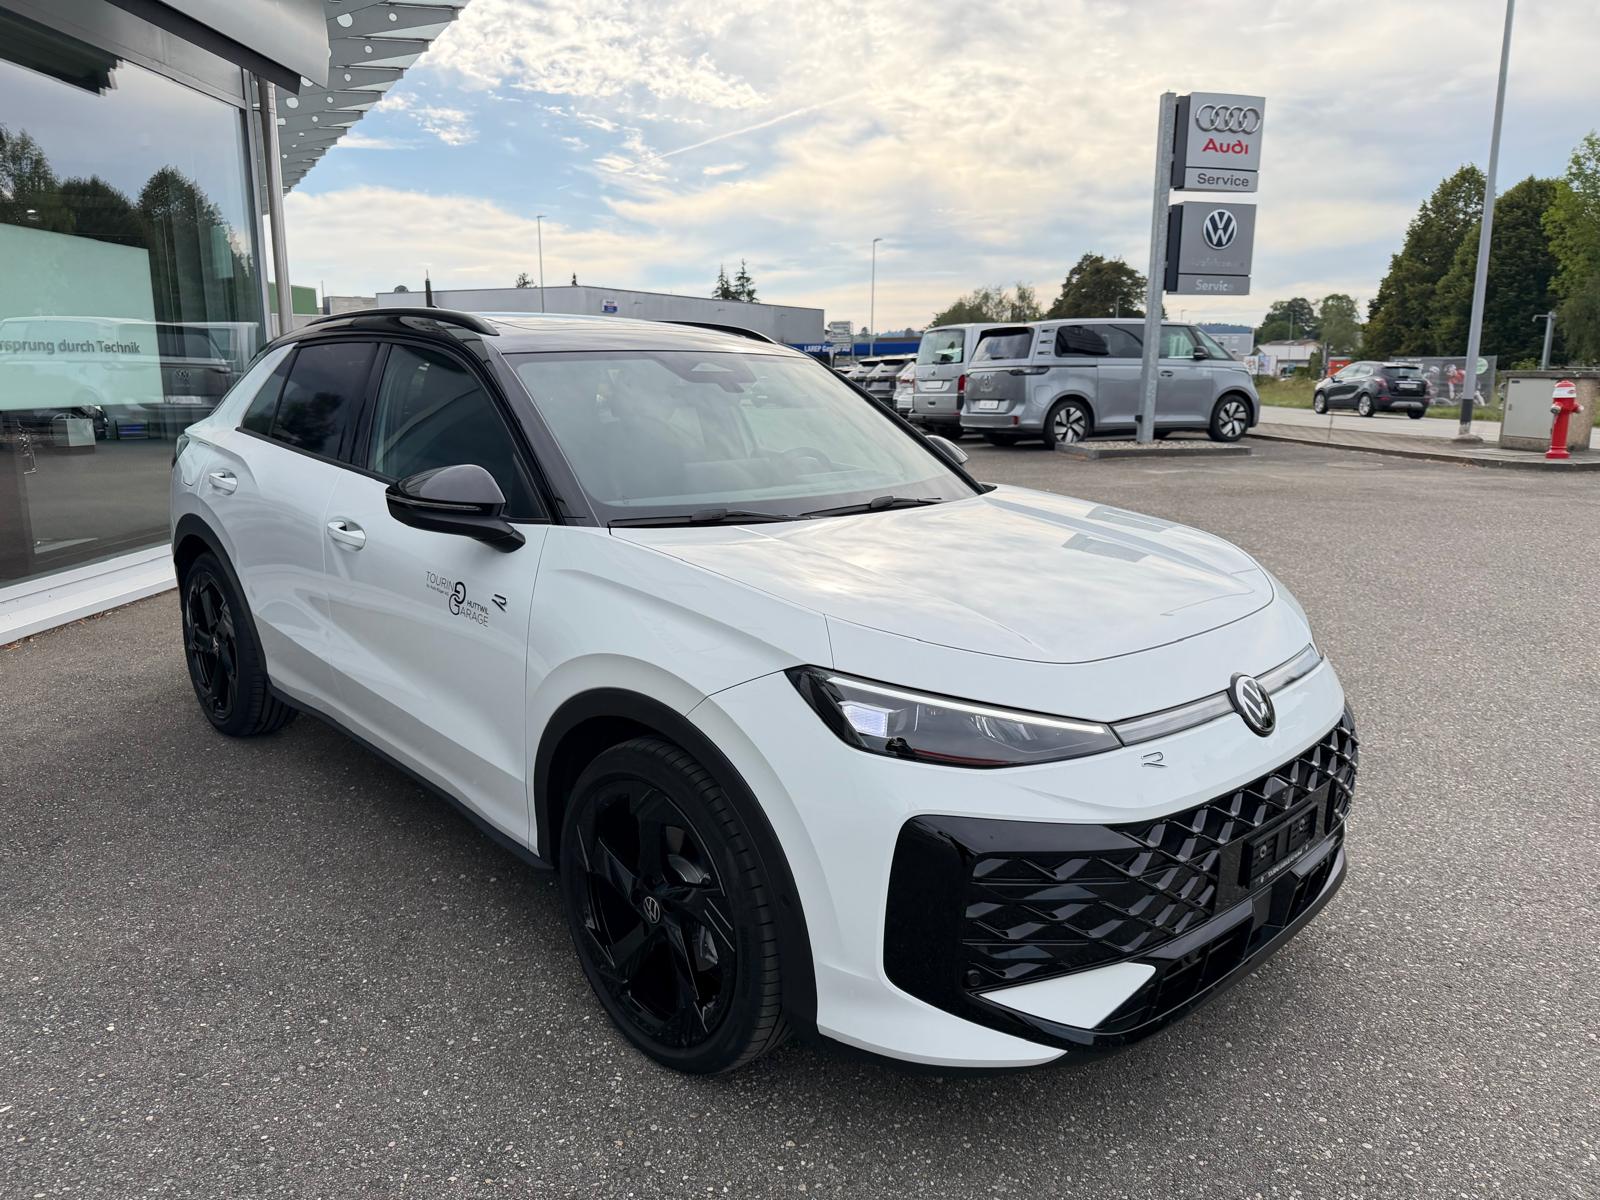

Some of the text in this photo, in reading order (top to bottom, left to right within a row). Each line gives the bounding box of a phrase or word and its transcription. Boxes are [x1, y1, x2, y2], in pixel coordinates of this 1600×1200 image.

[1202, 138, 1249, 155] Audi
[1197, 173, 1249, 187] Service
[1195, 279, 1233, 291] Servic
[59, 339, 95, 353] durch
[97, 340, 141, 354] Technik
